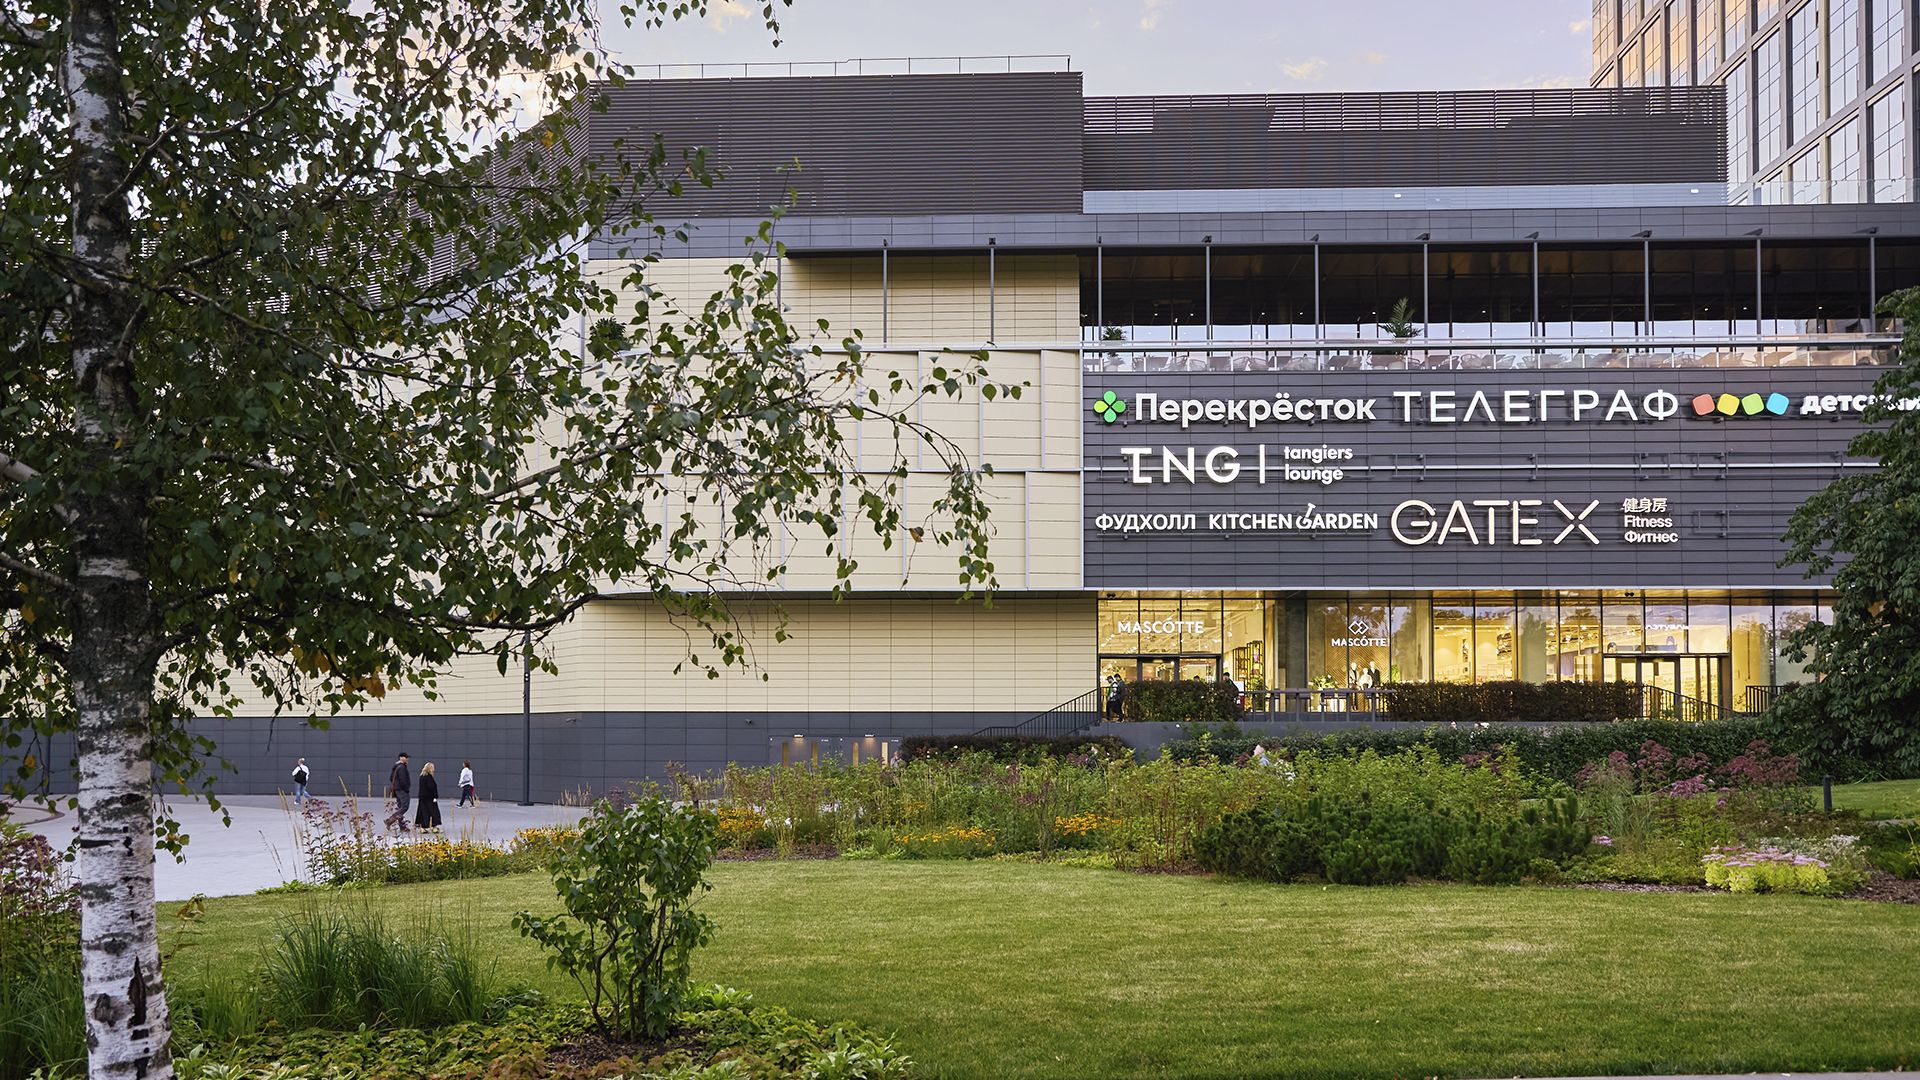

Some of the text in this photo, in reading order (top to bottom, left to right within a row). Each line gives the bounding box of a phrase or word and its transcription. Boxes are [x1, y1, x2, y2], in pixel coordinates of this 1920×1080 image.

[1135, 392, 1377, 428] Перекрёсток
[1393, 389, 1679, 423] ТЕЛЕГРАФ
[1284, 444, 1353, 464] tangiers
[1284, 464, 1344, 485] lounge
[1622, 497, 1668, 513] 健身房
[1095, 503, 1378, 533] ФУДХОЛЛ KITCHEN GARDEN
[1624, 514, 1673, 528] Fitness
[1624, 530, 1679, 543] Фитнес
[1117, 617, 1205, 634] MASCÓTTE
[1331, 635, 1387, 647] MASCÓTTE
